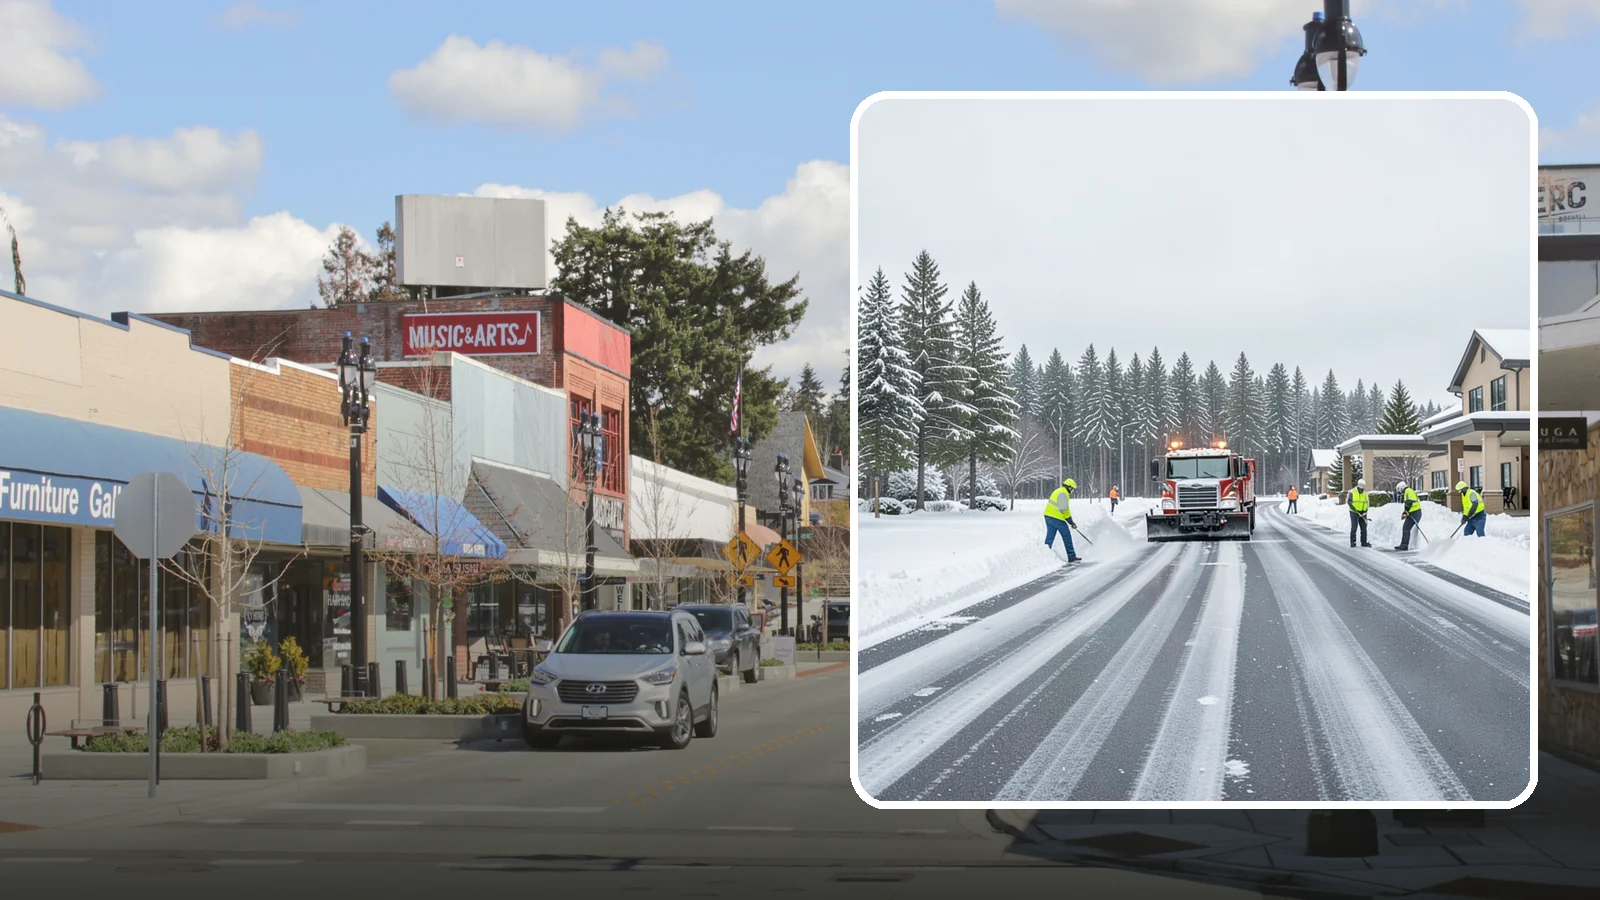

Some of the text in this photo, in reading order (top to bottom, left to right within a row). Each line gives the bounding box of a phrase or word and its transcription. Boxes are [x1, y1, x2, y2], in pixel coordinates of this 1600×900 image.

[409, 323, 519, 349] MUSIC&ARTS
[1540, 427, 1578, 437] UGA
[0, 471, 79, 515] Furniture
